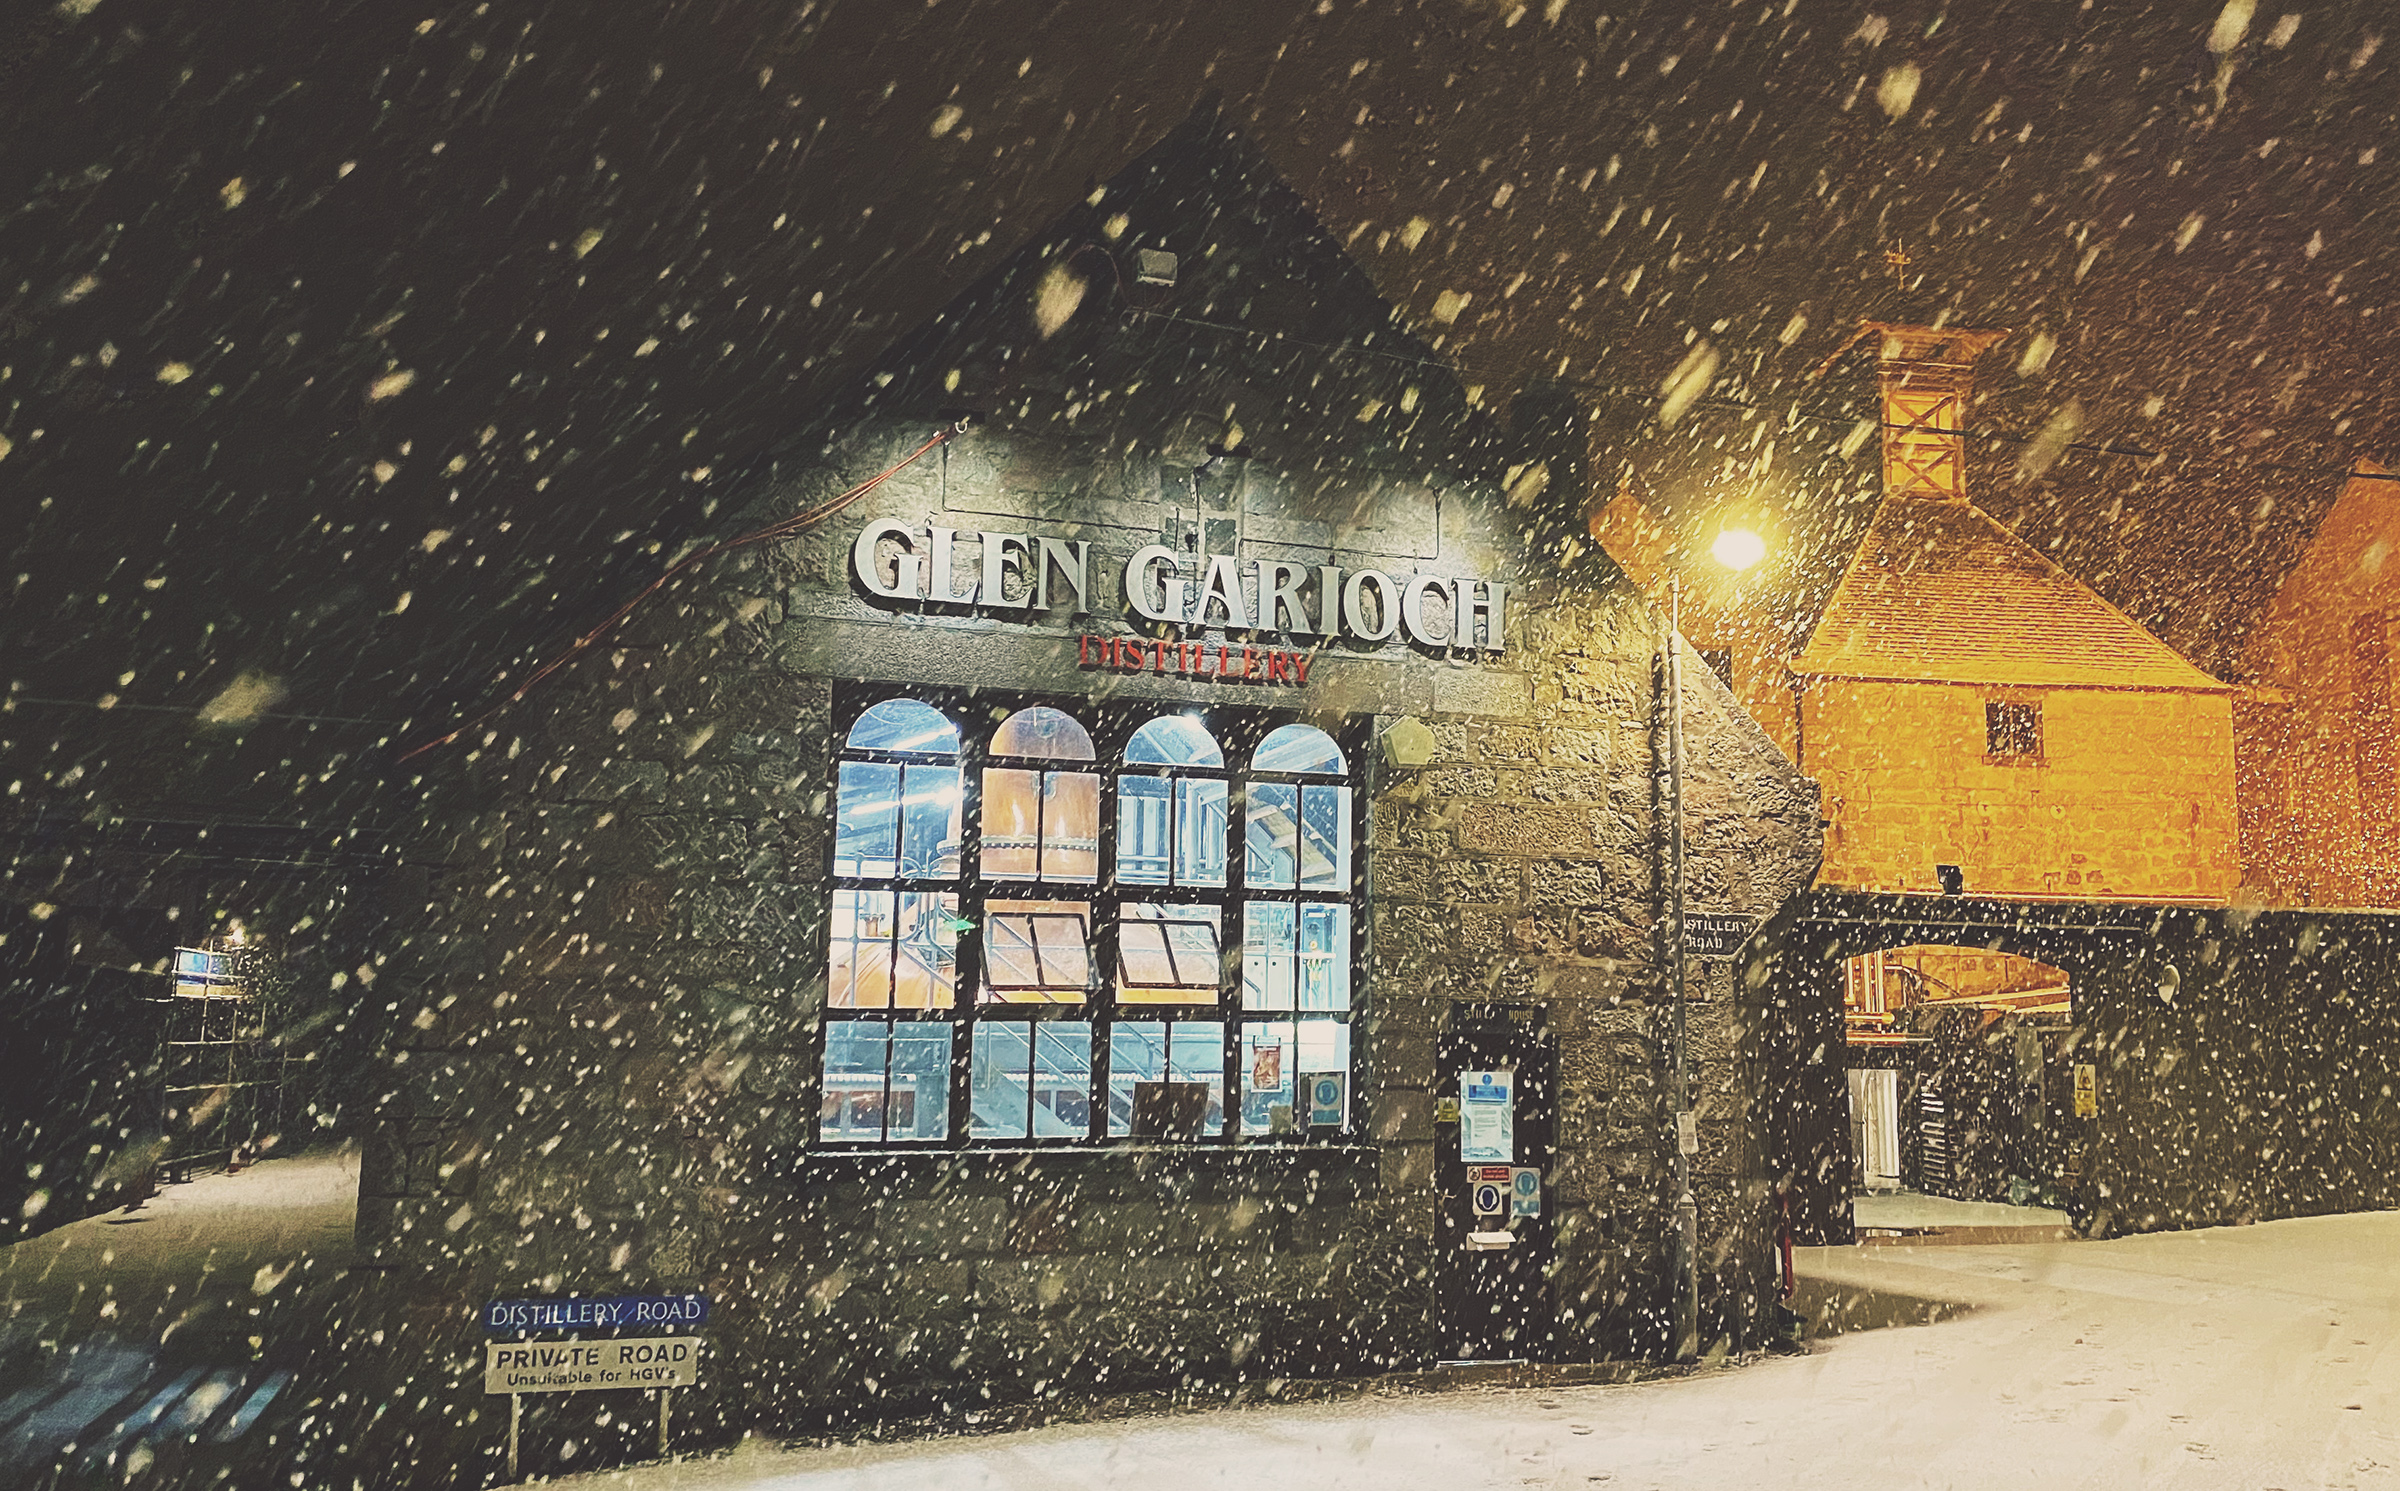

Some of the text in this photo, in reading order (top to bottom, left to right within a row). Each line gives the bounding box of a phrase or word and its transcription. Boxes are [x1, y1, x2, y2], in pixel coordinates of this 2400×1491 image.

[855, 517, 1507, 652] GLEN GARIOCH
[1079, 634, 1319, 683] DISTILLERY
[1683, 918, 1749, 933] ISTILLERY
[1688, 936, 1723, 949] ROAD
[490, 1301, 701, 1326] DISTILLERY ROAD
[496, 1343, 688, 1370] PRIVATE ROAD
[507, 1367, 676, 1387] Unsuitable for HGV's
